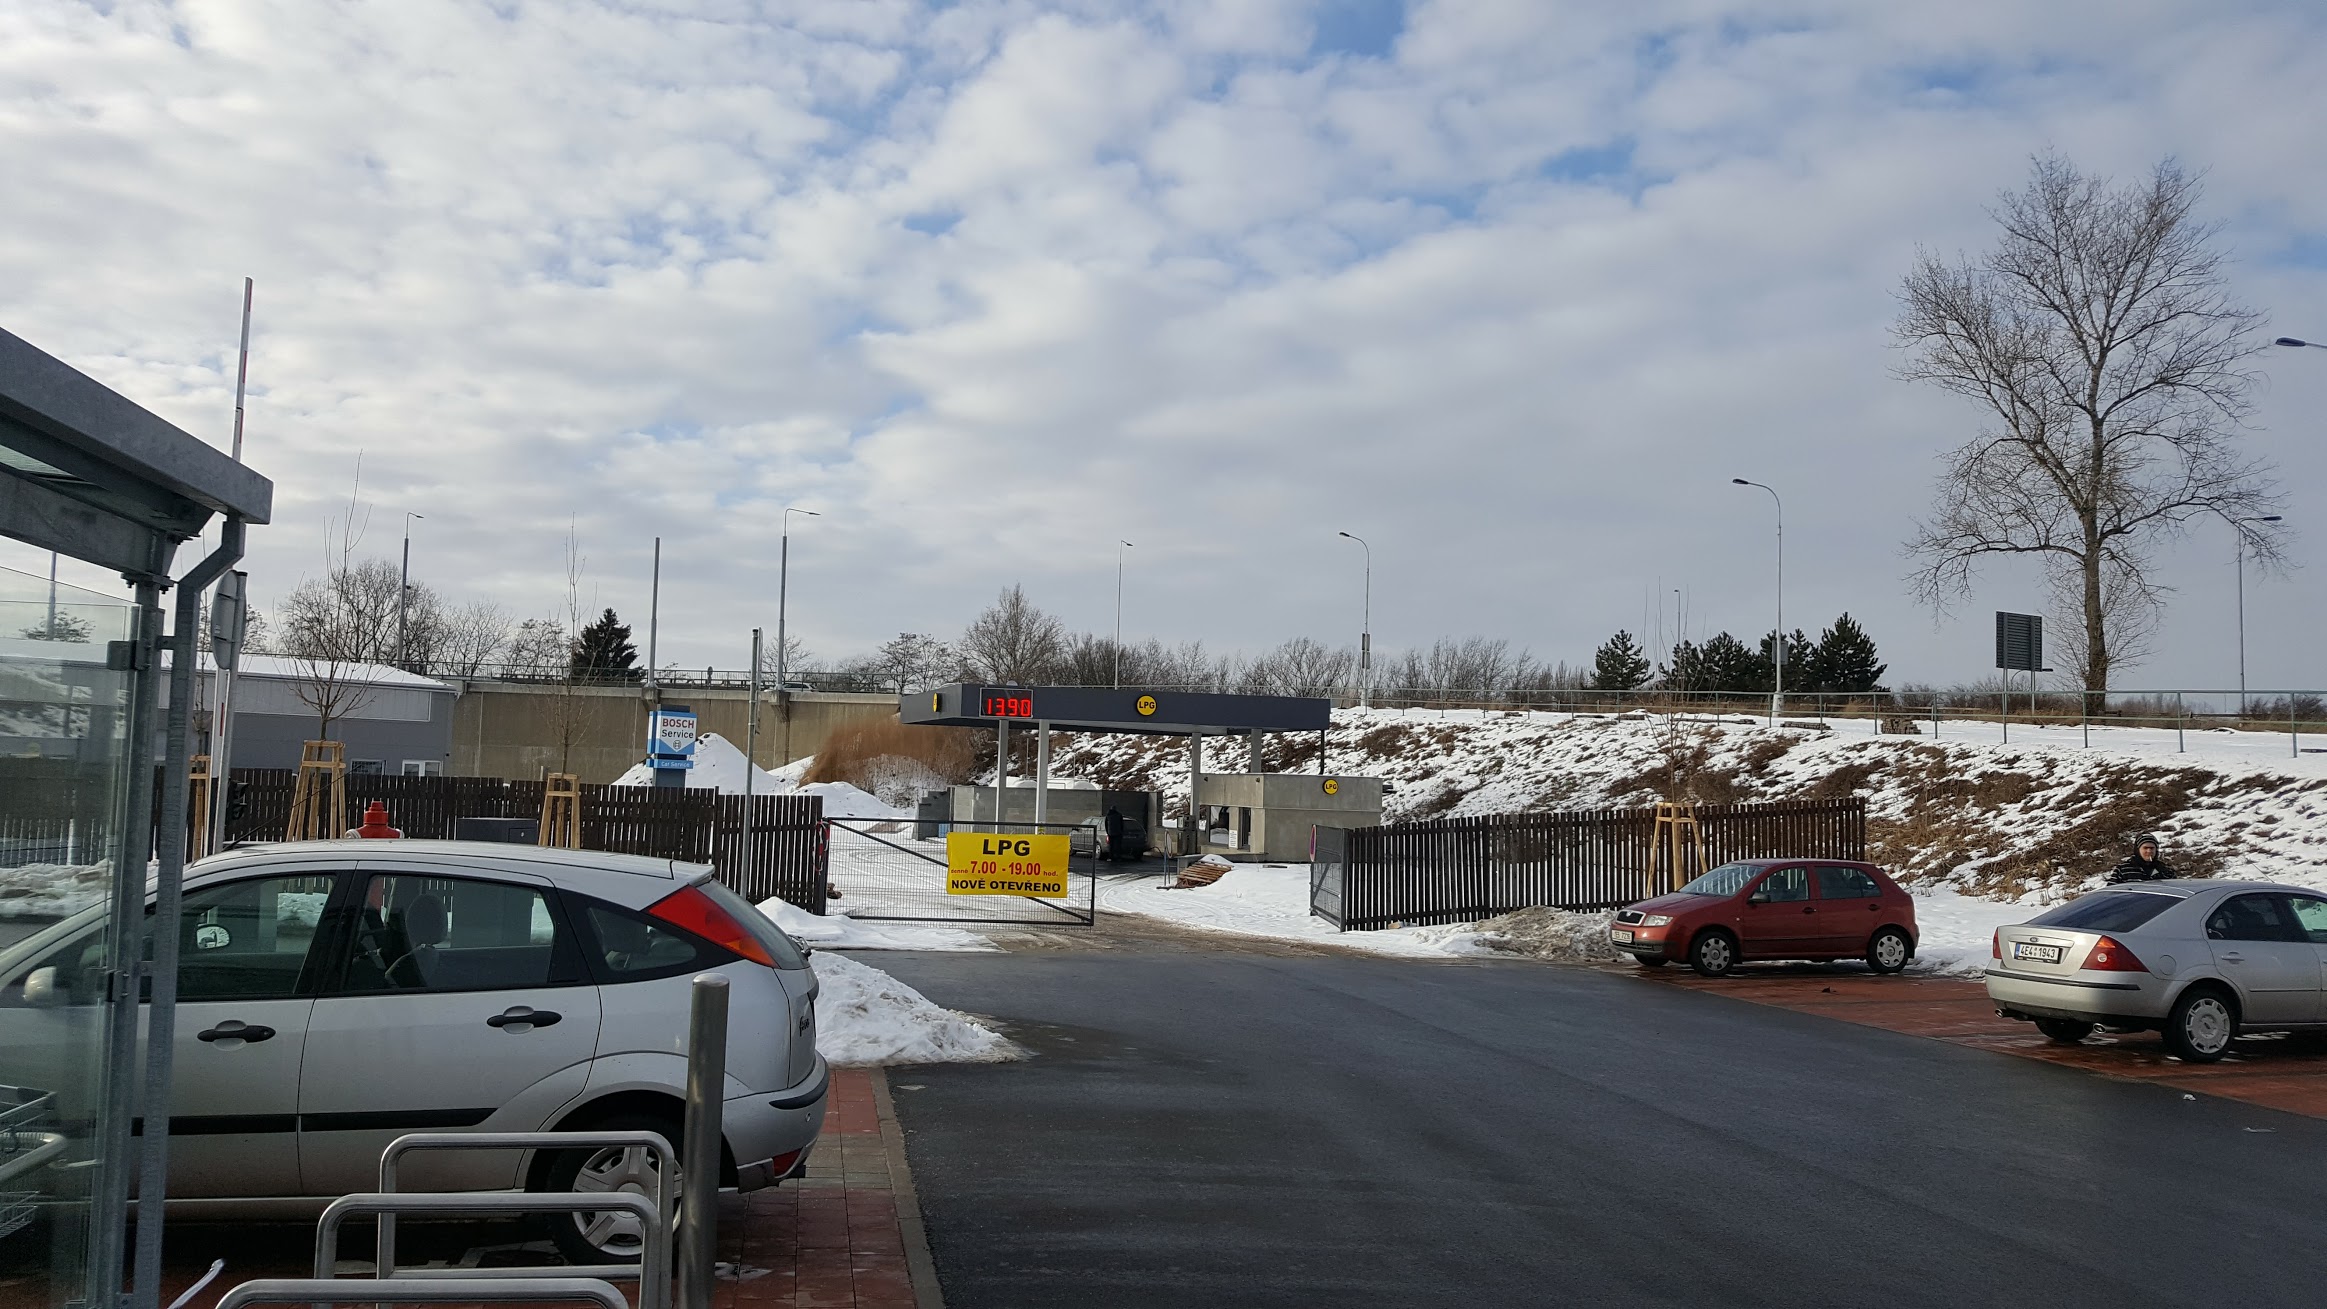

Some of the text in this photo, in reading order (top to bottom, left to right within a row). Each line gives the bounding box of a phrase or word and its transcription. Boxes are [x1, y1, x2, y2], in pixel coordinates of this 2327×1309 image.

[1138, 701, 1155, 709] LPG
[662, 718, 694, 728] BOSCH
[661, 729, 694, 739] Service
[982, 839, 1030, 856] LPG
[970, 861, 996, 874] 7.00
[1008, 862, 1040, 876] 19.00
[951, 878, 1061, 892] NOVĚ OTEVŘENO
[2020, 945, 2056, 958] 4E4 1943
